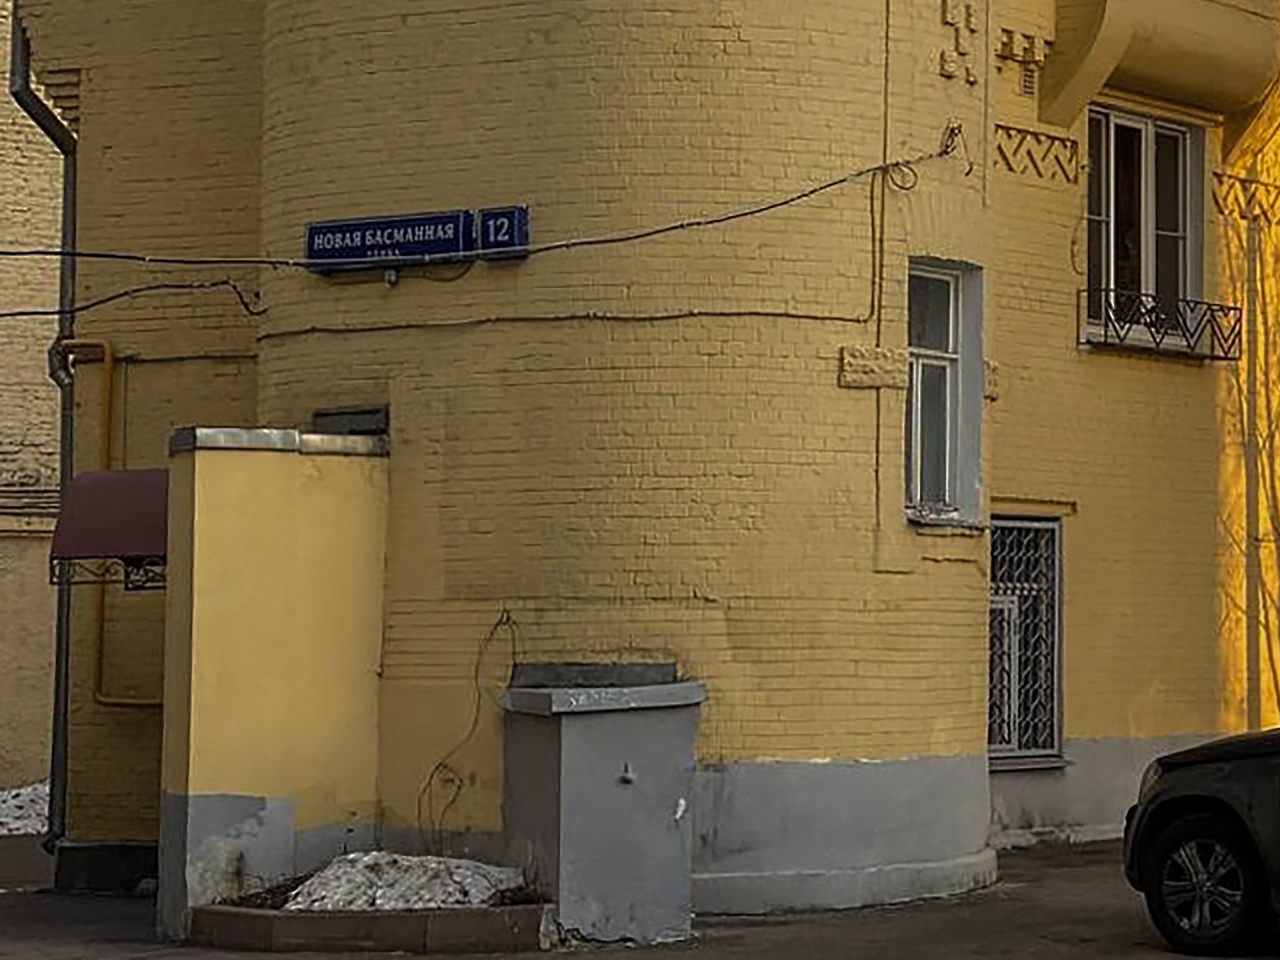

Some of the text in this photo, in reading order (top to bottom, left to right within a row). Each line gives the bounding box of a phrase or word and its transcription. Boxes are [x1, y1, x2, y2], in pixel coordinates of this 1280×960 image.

[314, 223, 454, 250] НОВАЯ БАСМАННАЯ
[487, 217, 510, 242] 12
